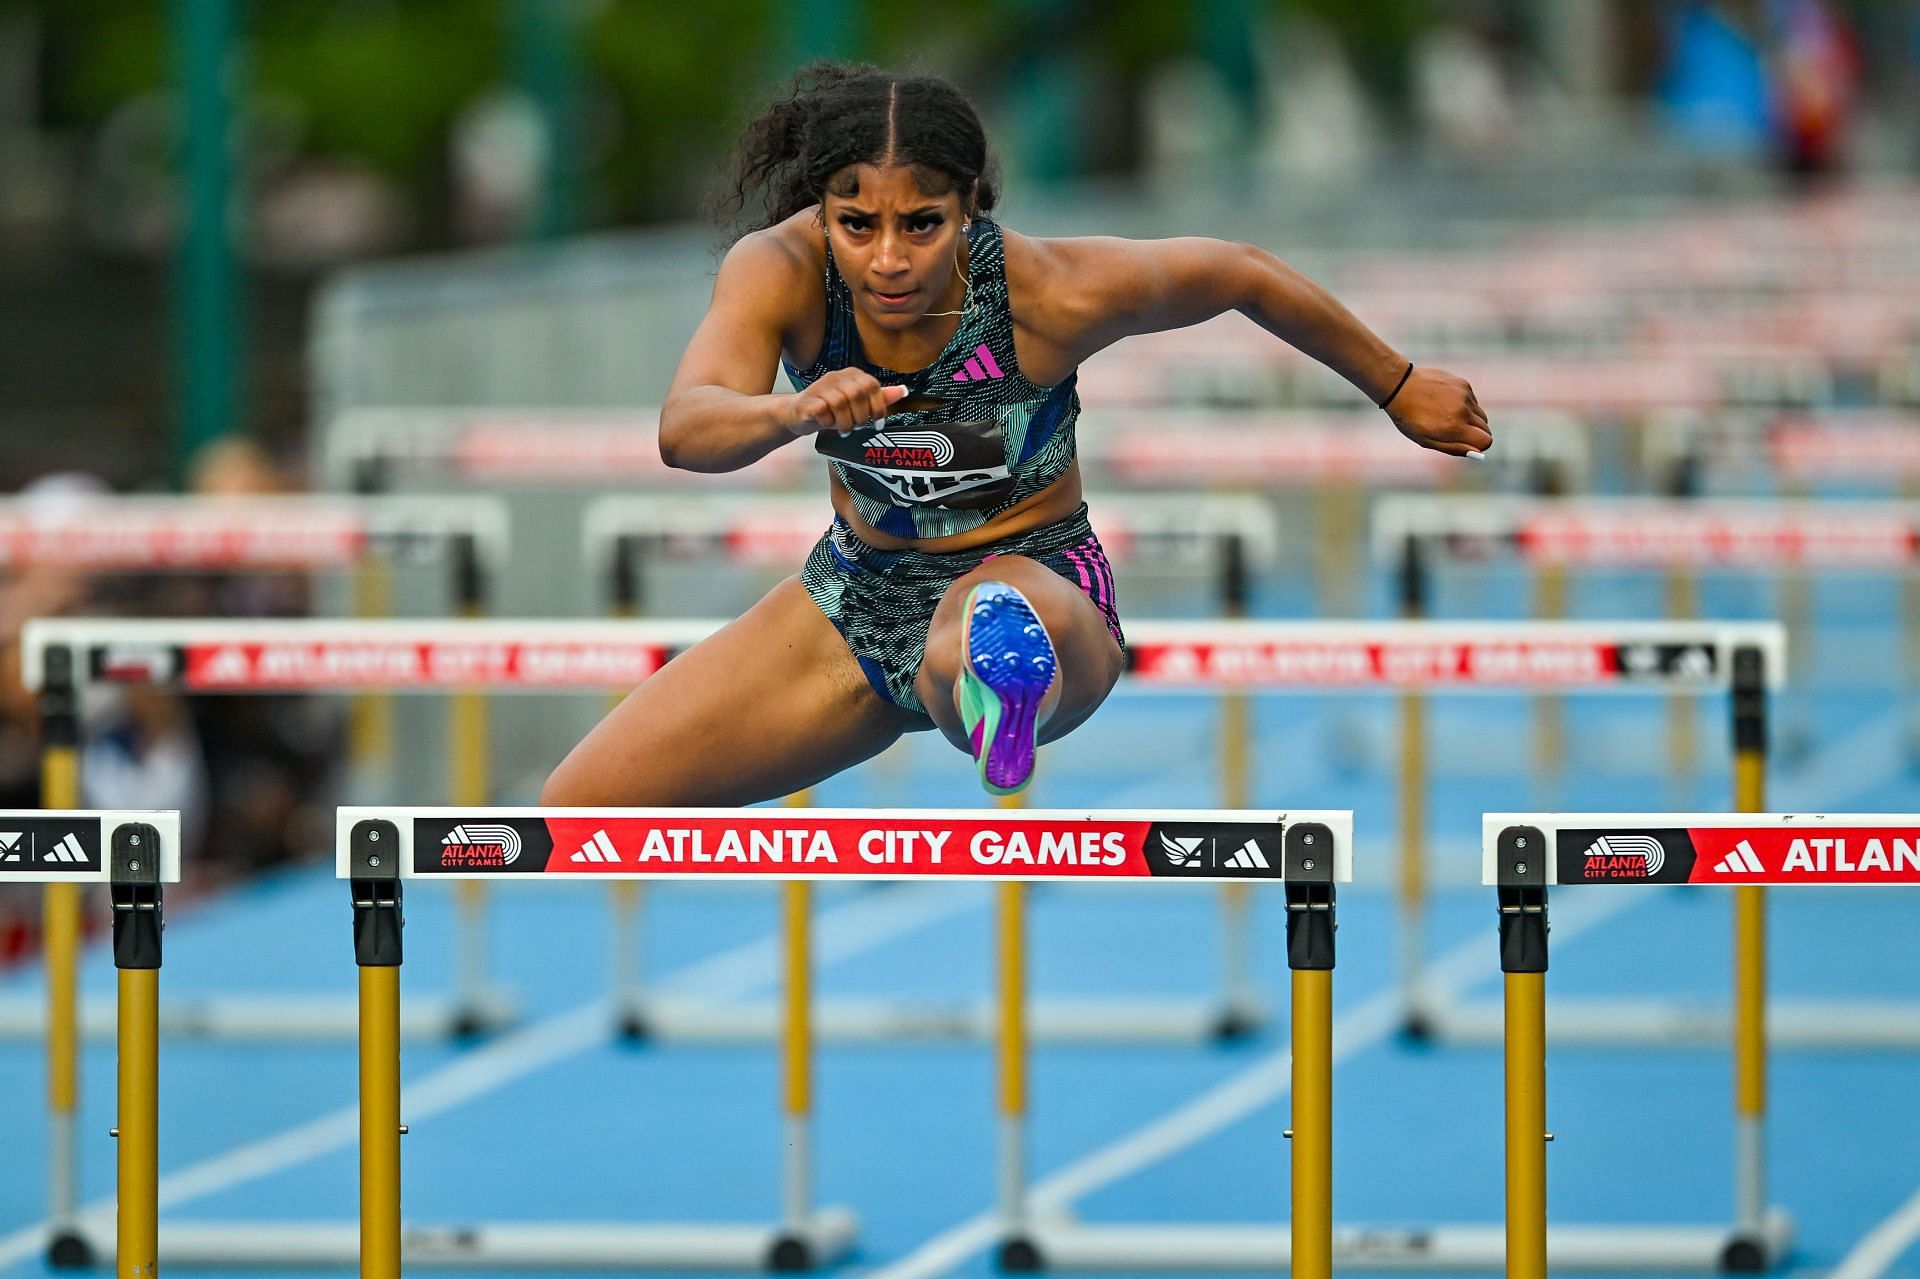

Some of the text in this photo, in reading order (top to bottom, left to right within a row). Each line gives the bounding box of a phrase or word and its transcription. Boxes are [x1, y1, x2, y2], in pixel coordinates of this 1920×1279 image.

[864, 447, 935, 461] ATLANTA
[895, 459, 936, 468] GAMES
[441, 844, 503, 858] ATLANTA
[638, 829, 1127, 866] ATLANTA CITY GAMES
[441, 858, 504, 867] CITY GAMES
[1584, 855, 1646, 869] ATLANTA
[1584, 869, 1647, 878] CITY GAMES
